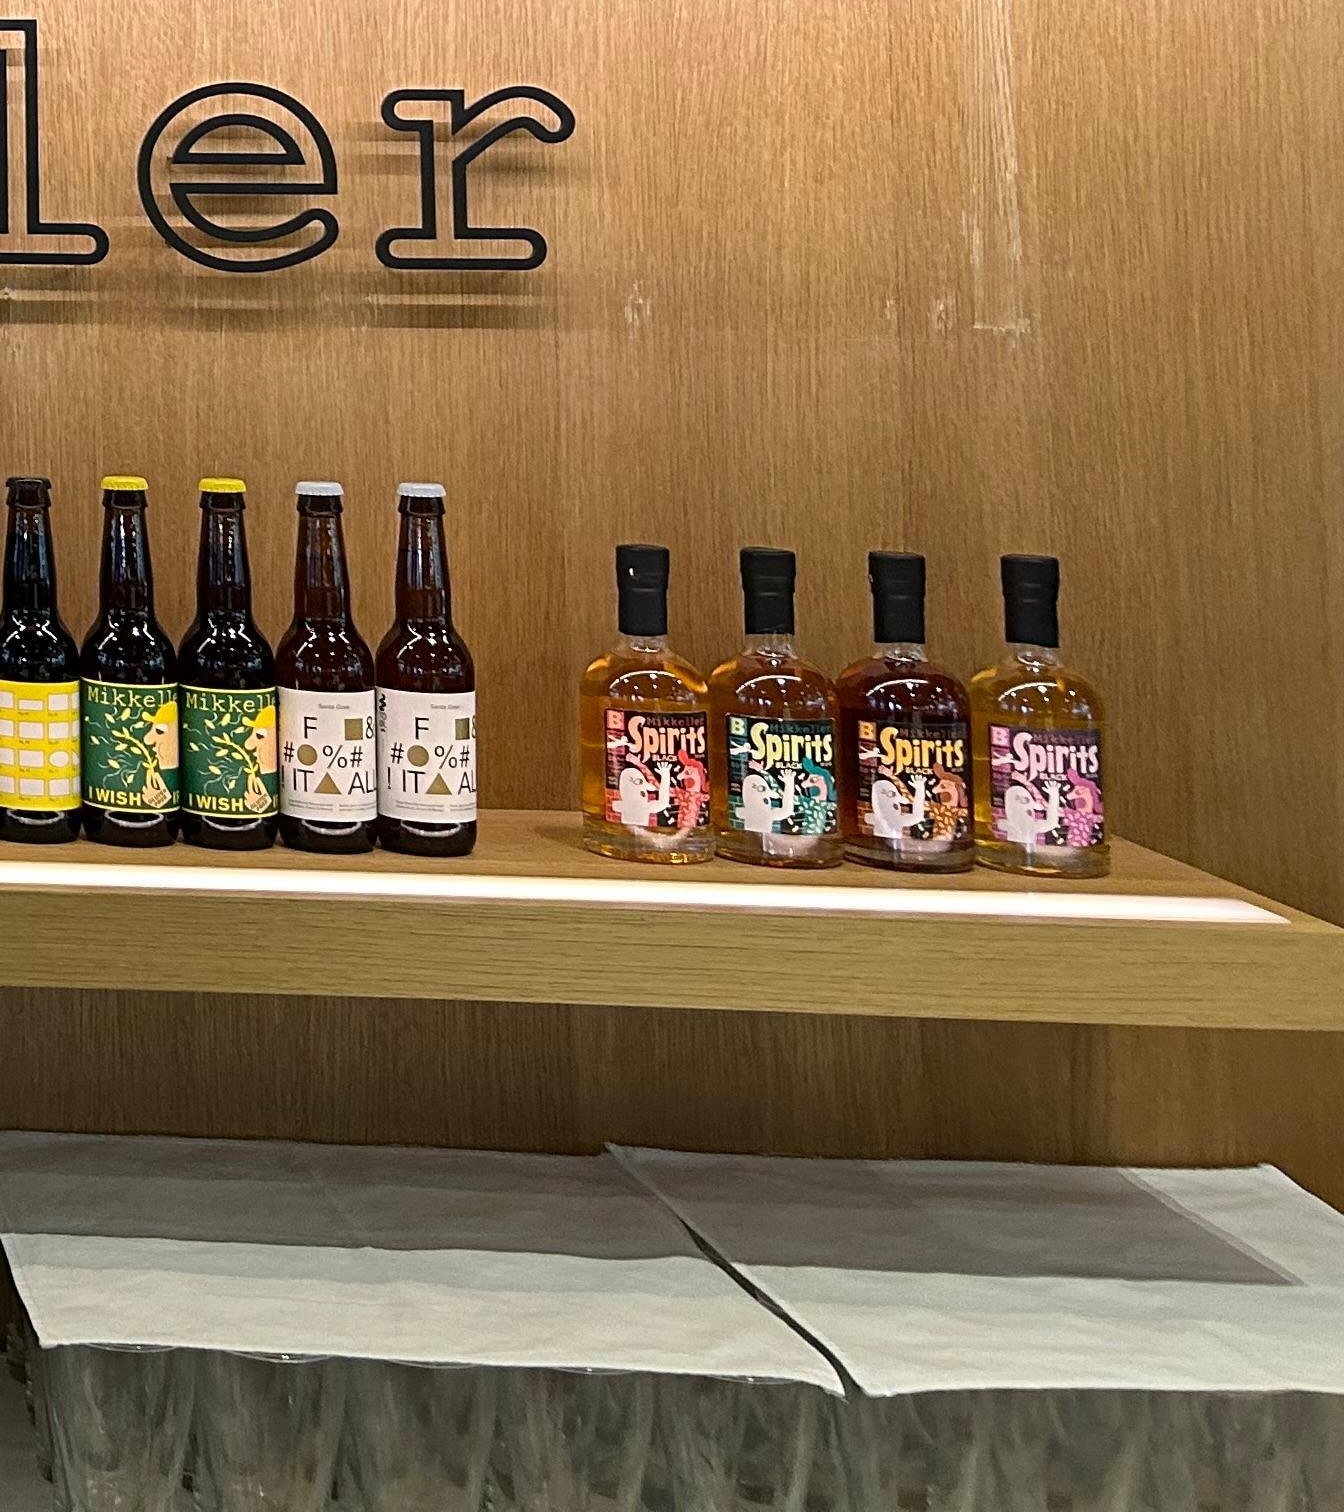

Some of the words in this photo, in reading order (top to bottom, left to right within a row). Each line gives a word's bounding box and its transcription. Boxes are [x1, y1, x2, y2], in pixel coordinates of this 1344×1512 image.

[627, 715, 705, 764] Spirits
[646, 715, 705, 727] Mikkeller
[750, 722, 832, 770] Spirits
[879, 726, 964, 776] Spirits
[1012, 732, 1099, 782] Spirits
[95, 787, 142, 806] WISH
[196, 794, 244, 812] WISH
